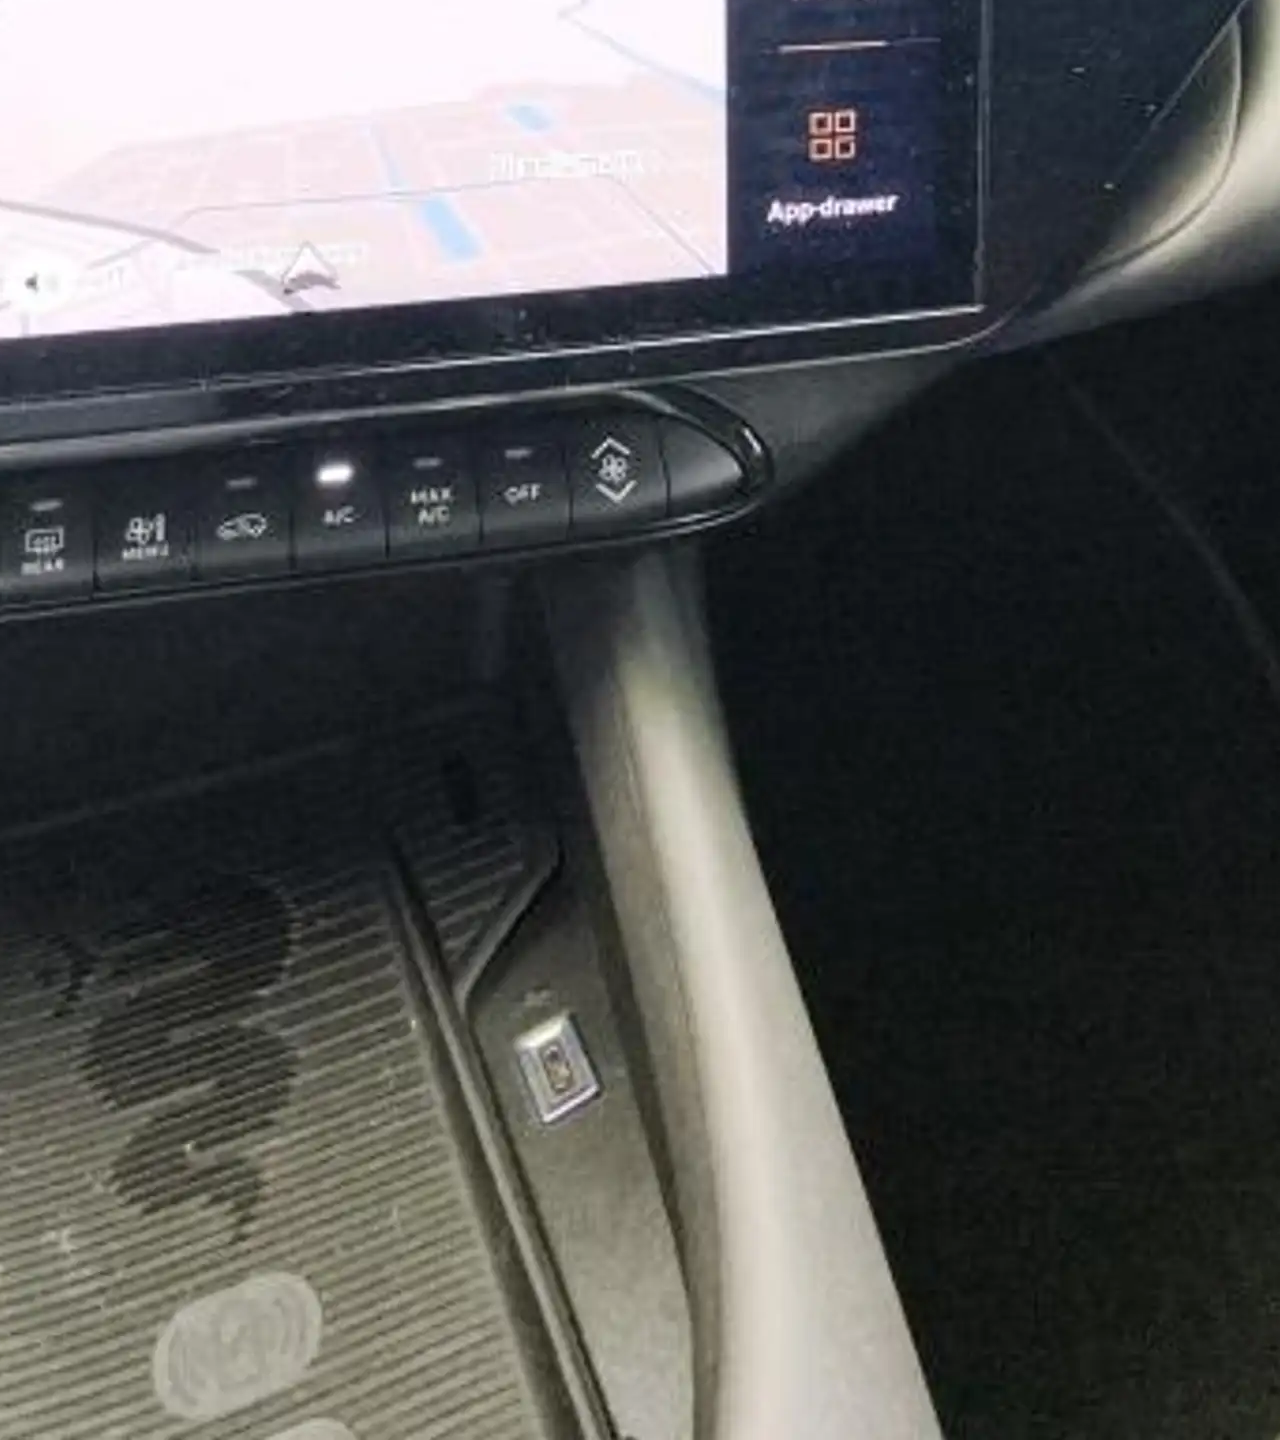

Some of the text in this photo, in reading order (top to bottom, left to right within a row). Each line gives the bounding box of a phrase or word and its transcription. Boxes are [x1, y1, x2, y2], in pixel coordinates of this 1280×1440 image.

[766, 195, 900, 227] App-drawer
[503, 483, 542, 507] OFF
[323, 505, 357, 526] A/C
